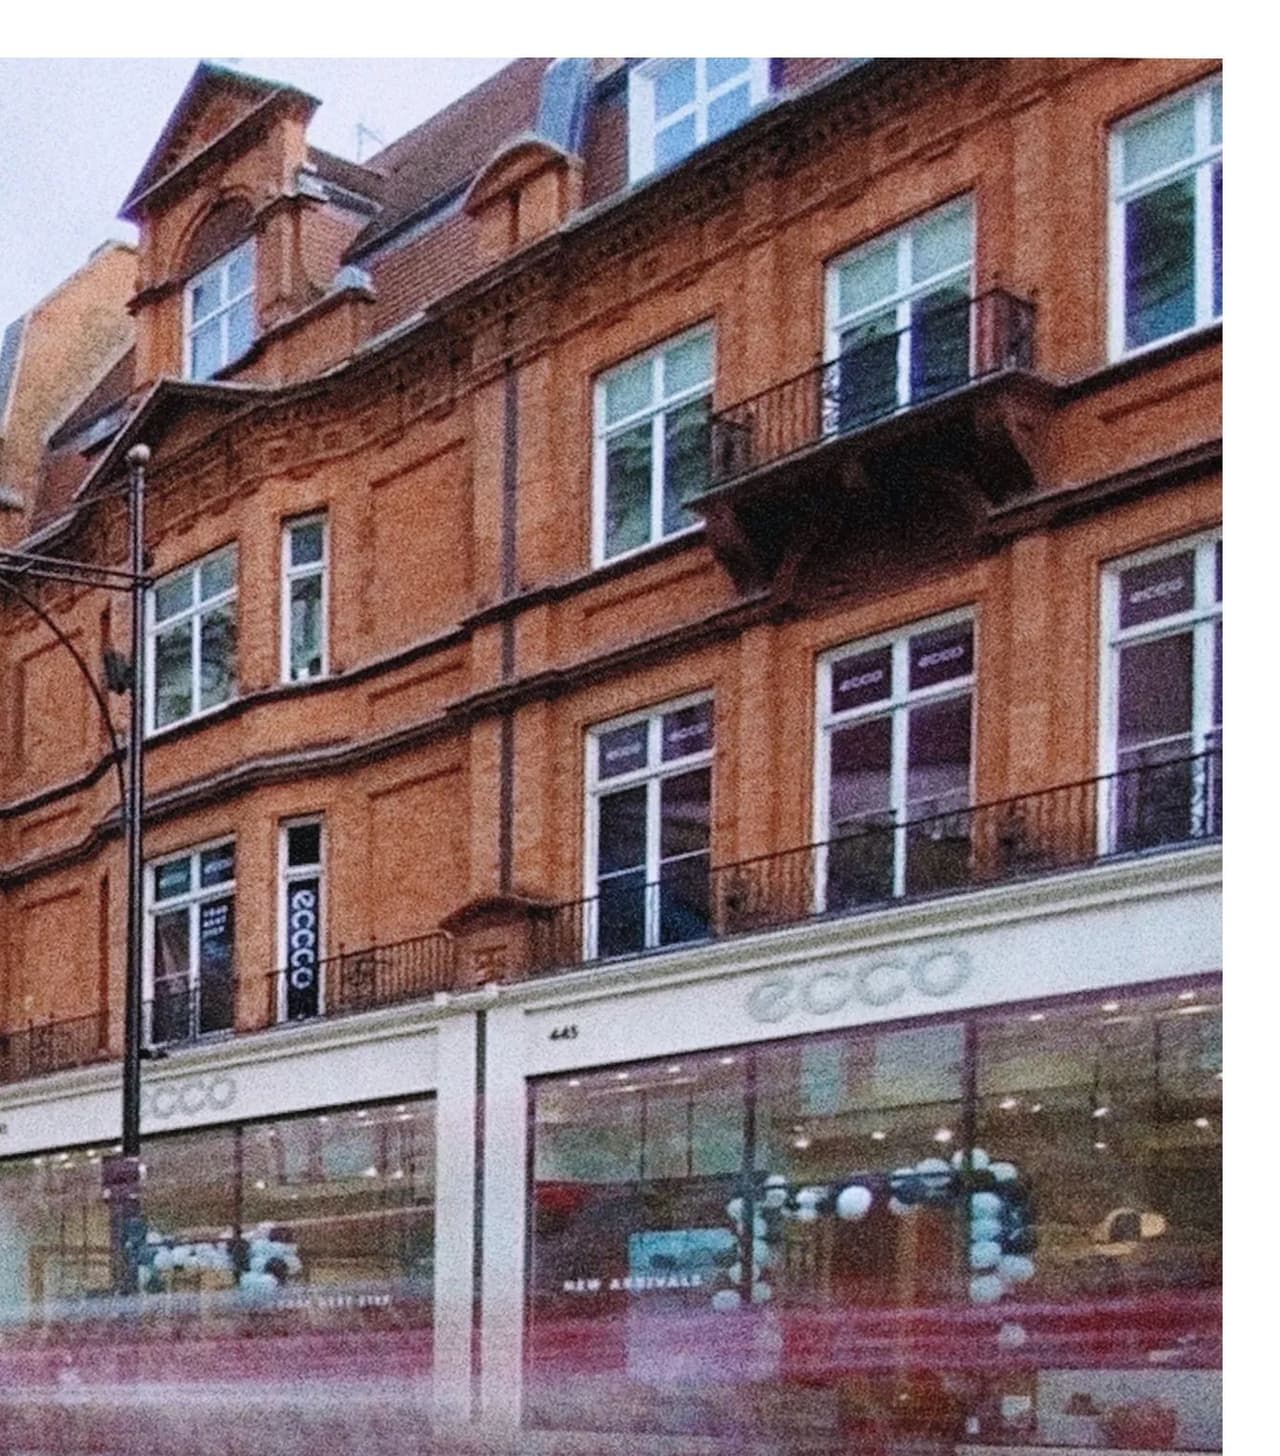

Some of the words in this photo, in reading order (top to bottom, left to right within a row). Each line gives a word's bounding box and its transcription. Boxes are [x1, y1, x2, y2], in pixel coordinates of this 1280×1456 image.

[747, 947, 973, 1024] ecco
[140, 1075, 238, 1120] cco
[563, 1278, 601, 1292] NEW
[609, 1274, 704, 1291] ARRIVALS
